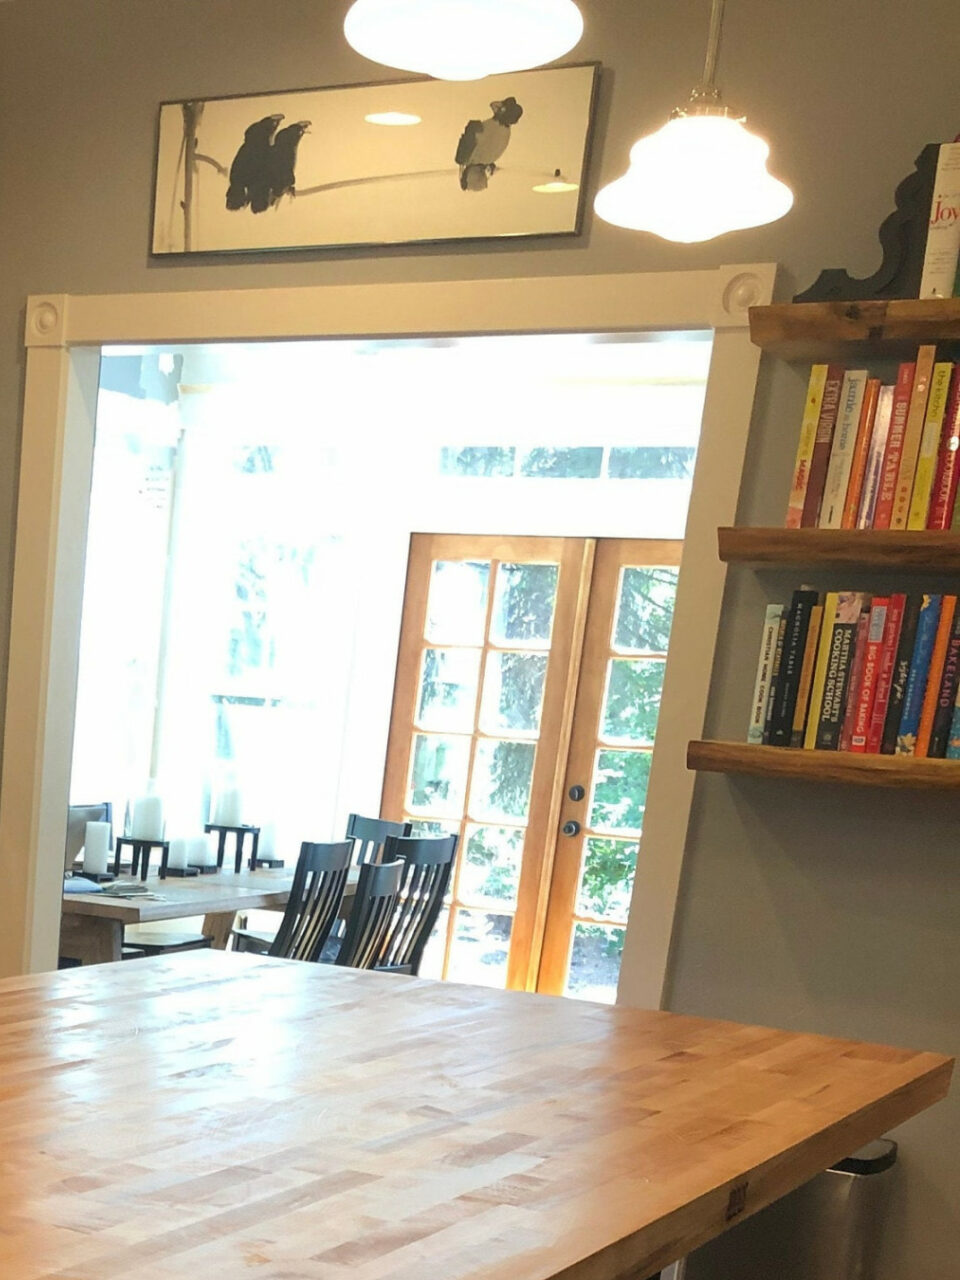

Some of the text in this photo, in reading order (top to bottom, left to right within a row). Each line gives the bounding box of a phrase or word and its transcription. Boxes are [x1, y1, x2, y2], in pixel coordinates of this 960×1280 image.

[846, 376, 859, 413] jamie
[935, 370, 946, 386] the
[816, 379, 840, 443] EXTRA VIRGIN
[841, 422, 851, 450] home
[881, 402, 908, 501] SUMMER TABLE
[763, 627, 774, 662] CHRISTIAN
[786, 603, 803, 675] MAGNOLIA TABLE
[839, 629, 852, 669] MARTHA
[867, 645, 878, 661] BIG
[760, 663, 769, 682] HOME
[820, 628, 844, 722] COOKING SCHOOL
[864, 662, 875, 687] BOOK
[941, 639, 960, 707] BAKELAND
[831, 670, 847, 722] STEWART'S
[861, 689, 871, 701] OF
[856, 703, 869, 733] BAKING
